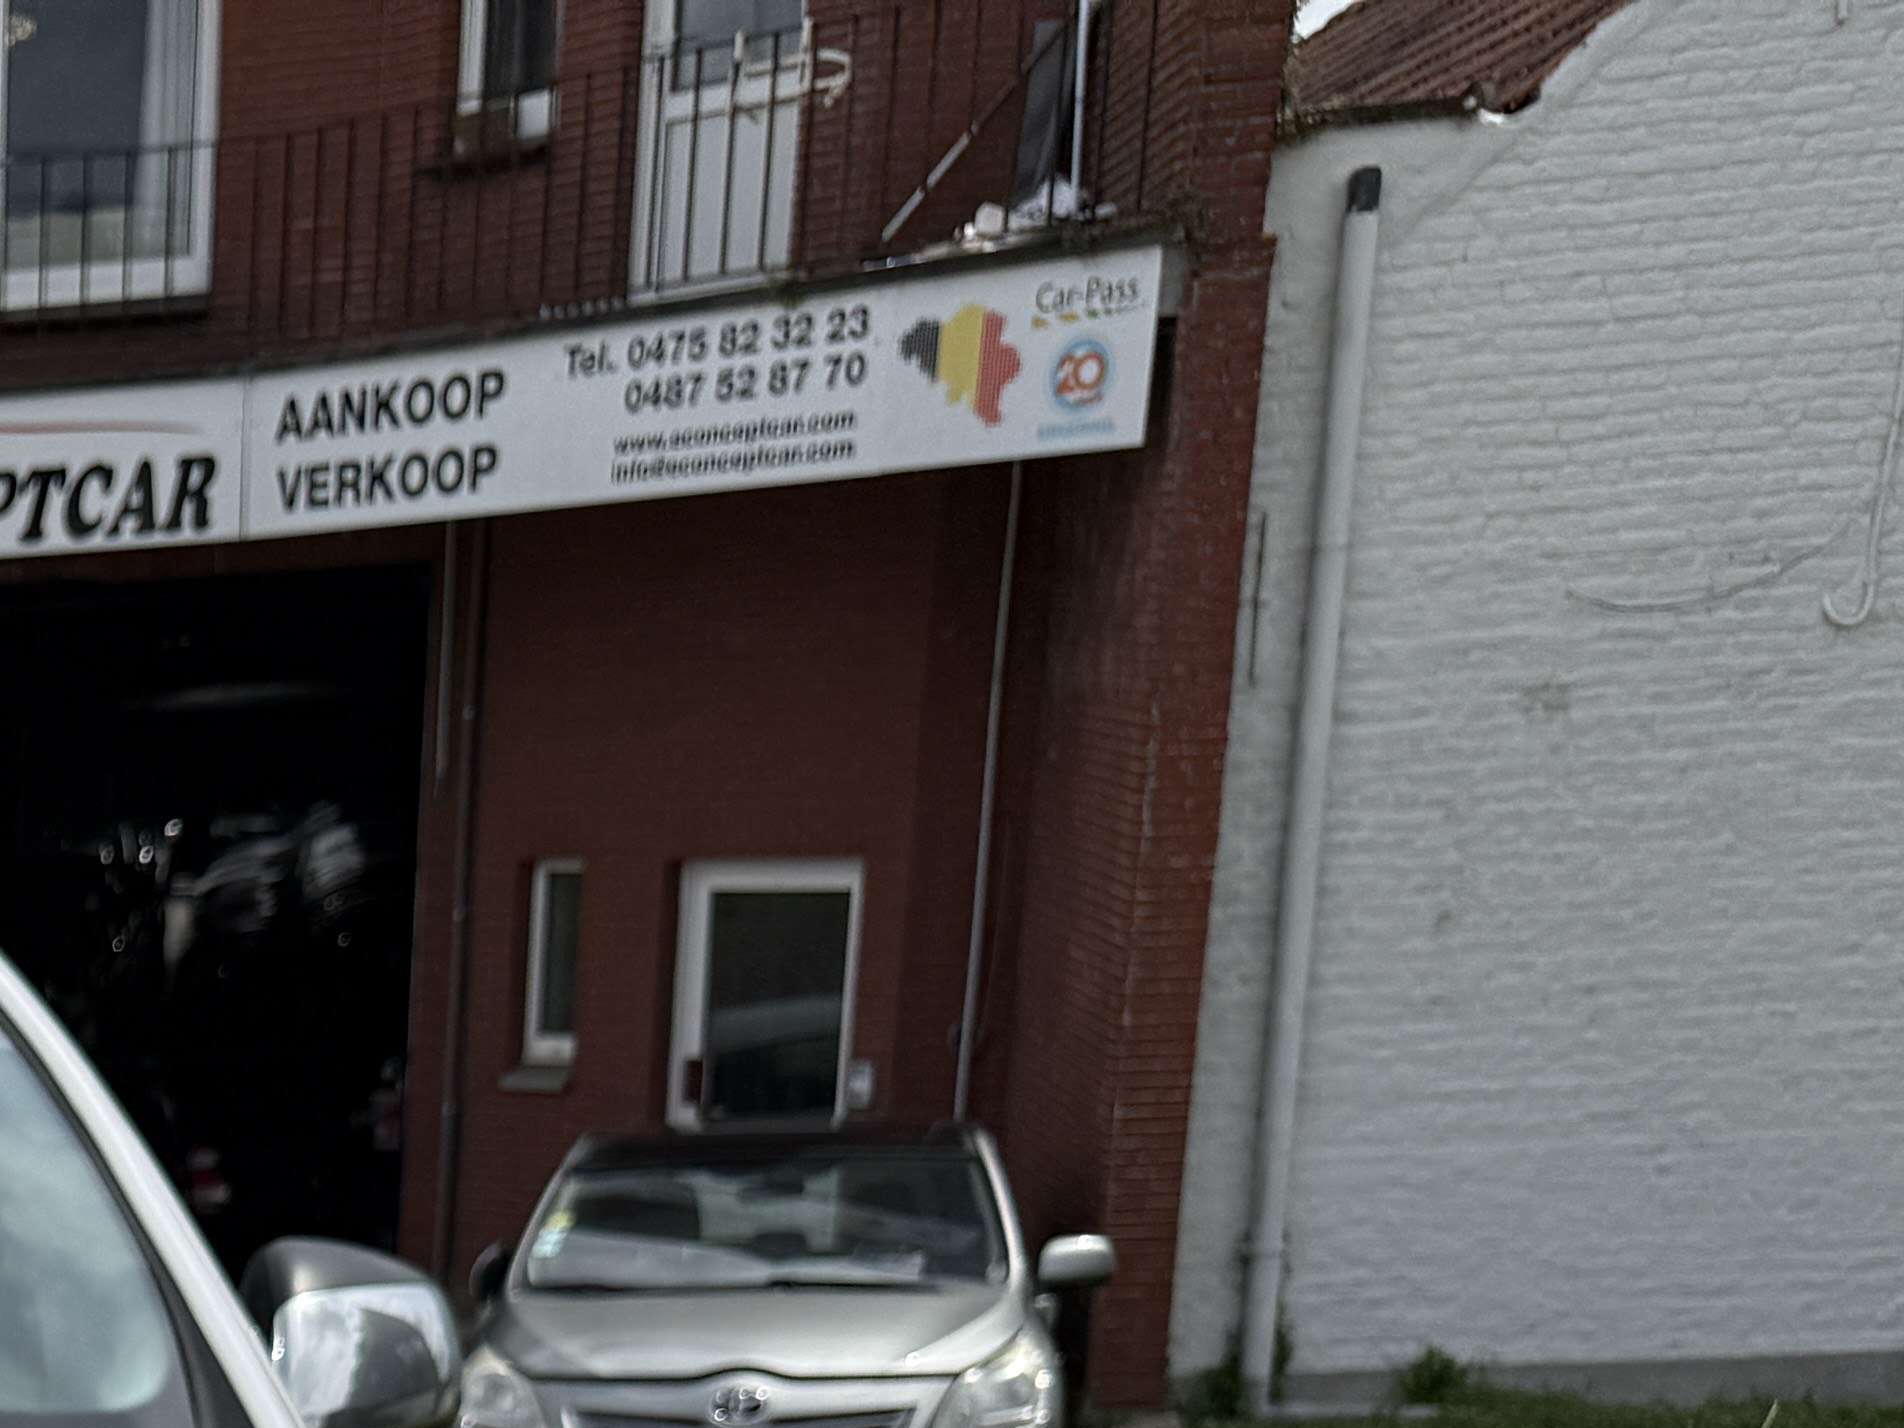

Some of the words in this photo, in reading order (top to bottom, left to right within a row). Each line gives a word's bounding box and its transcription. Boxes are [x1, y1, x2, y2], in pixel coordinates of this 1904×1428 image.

[1036, 276, 1140, 313] Car-Pass
[565, 342, 616, 376] Tel.
[627, 325, 708, 369] 0475
[718, 319, 761, 358] 82
[771, 312, 814, 349] 32
[826, 303, 871, 341] 23
[275, 368, 508, 444] AANKOOP
[624, 372, 703, 413] 0487
[715, 366, 756, 401] 52
[768, 359, 809, 395] 87
[825, 351, 867, 387] 70
[276, 446, 499, 514] VERKOOP
